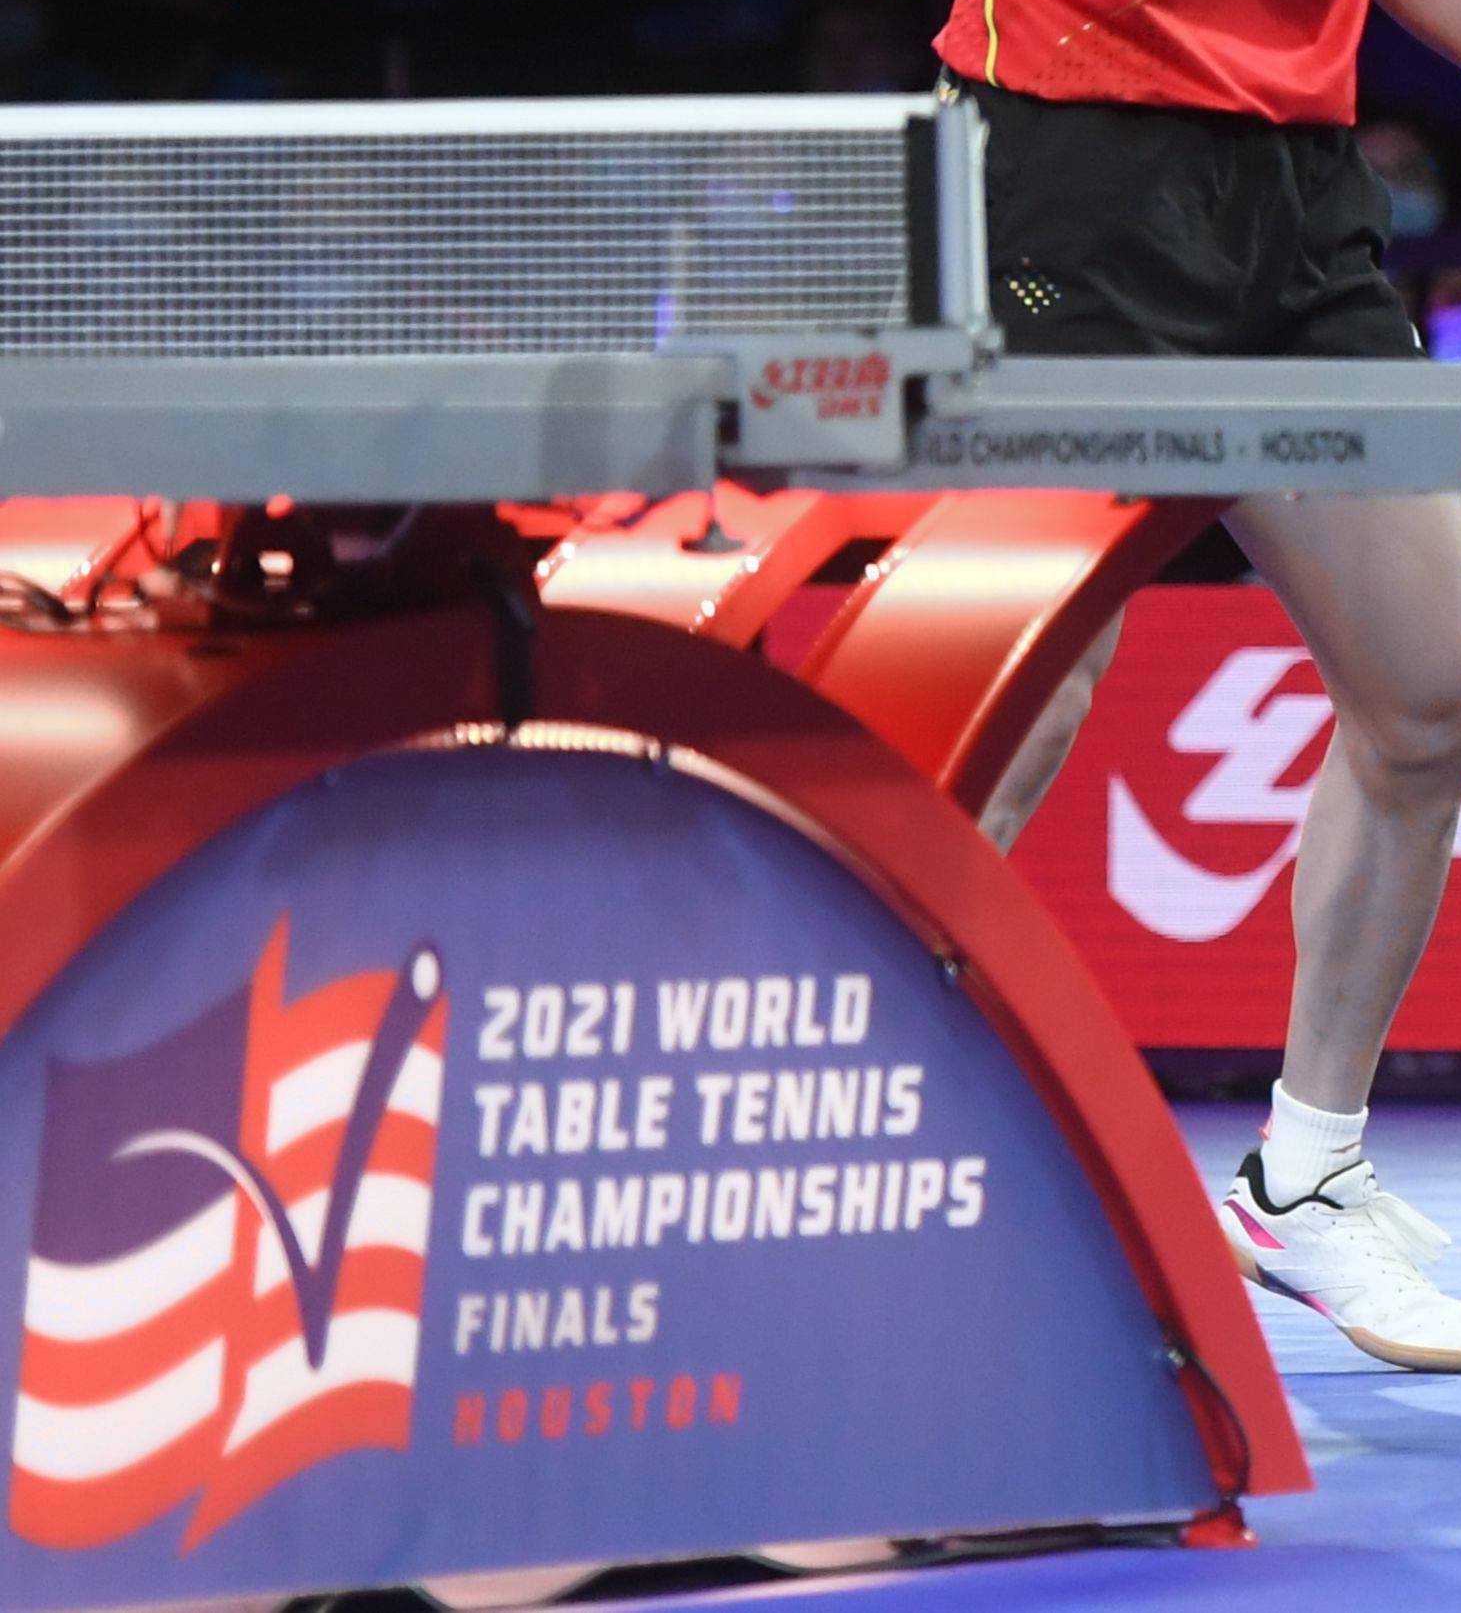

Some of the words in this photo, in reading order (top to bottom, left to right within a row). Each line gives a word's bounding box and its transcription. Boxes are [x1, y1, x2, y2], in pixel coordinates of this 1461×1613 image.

[477, 982, 637, 1063] 2021
[657, 973, 873, 1054] WORLD
[474, 1075, 675, 1159] TABLE
[697, 1067, 924, 1150] TENNIS
[461, 1158, 987, 1257] CHAMPIONSHIPS
[453, 1283, 661, 1355] FINALS
[452, 1374, 743, 1446] HOUSTON
